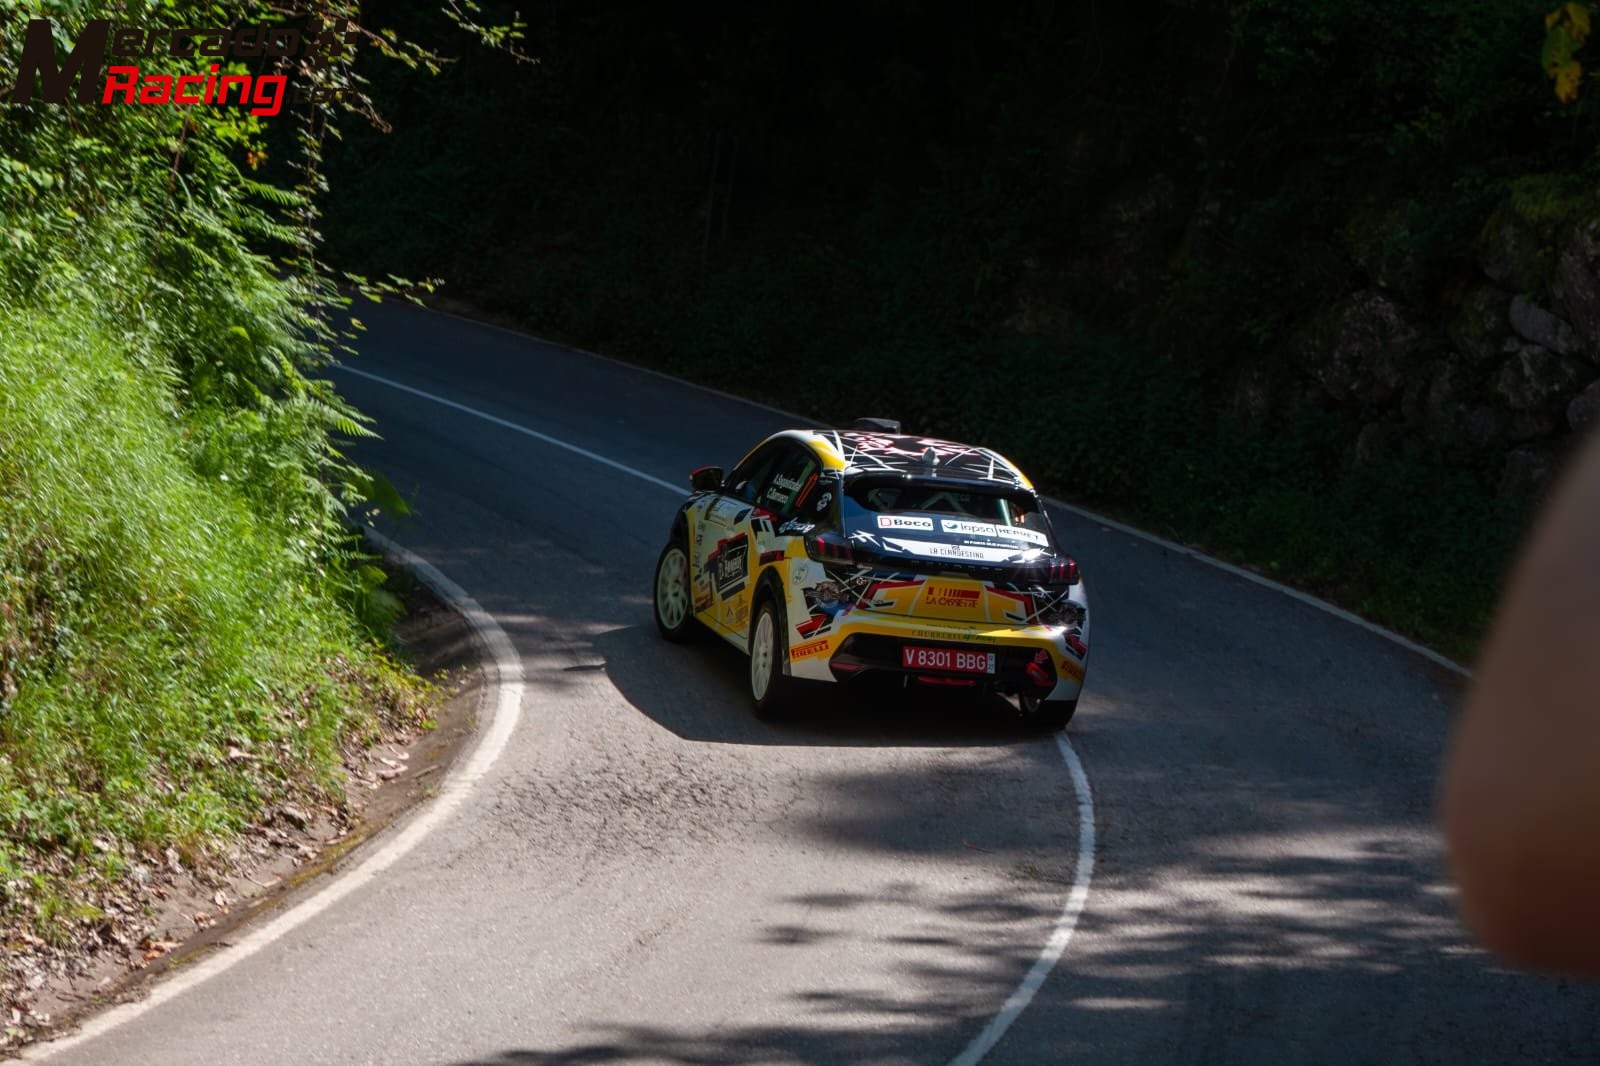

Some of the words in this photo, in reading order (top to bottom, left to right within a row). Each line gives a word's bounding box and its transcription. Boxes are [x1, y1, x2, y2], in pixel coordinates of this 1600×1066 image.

[894, 519, 932, 527] Beco
[926, 596, 936, 605] LA
[791, 640, 829, 658] PIRELLI
[905, 649, 915, 665] V
[918, 650, 951, 667] 8301
[956, 653, 986, 670] BBG
